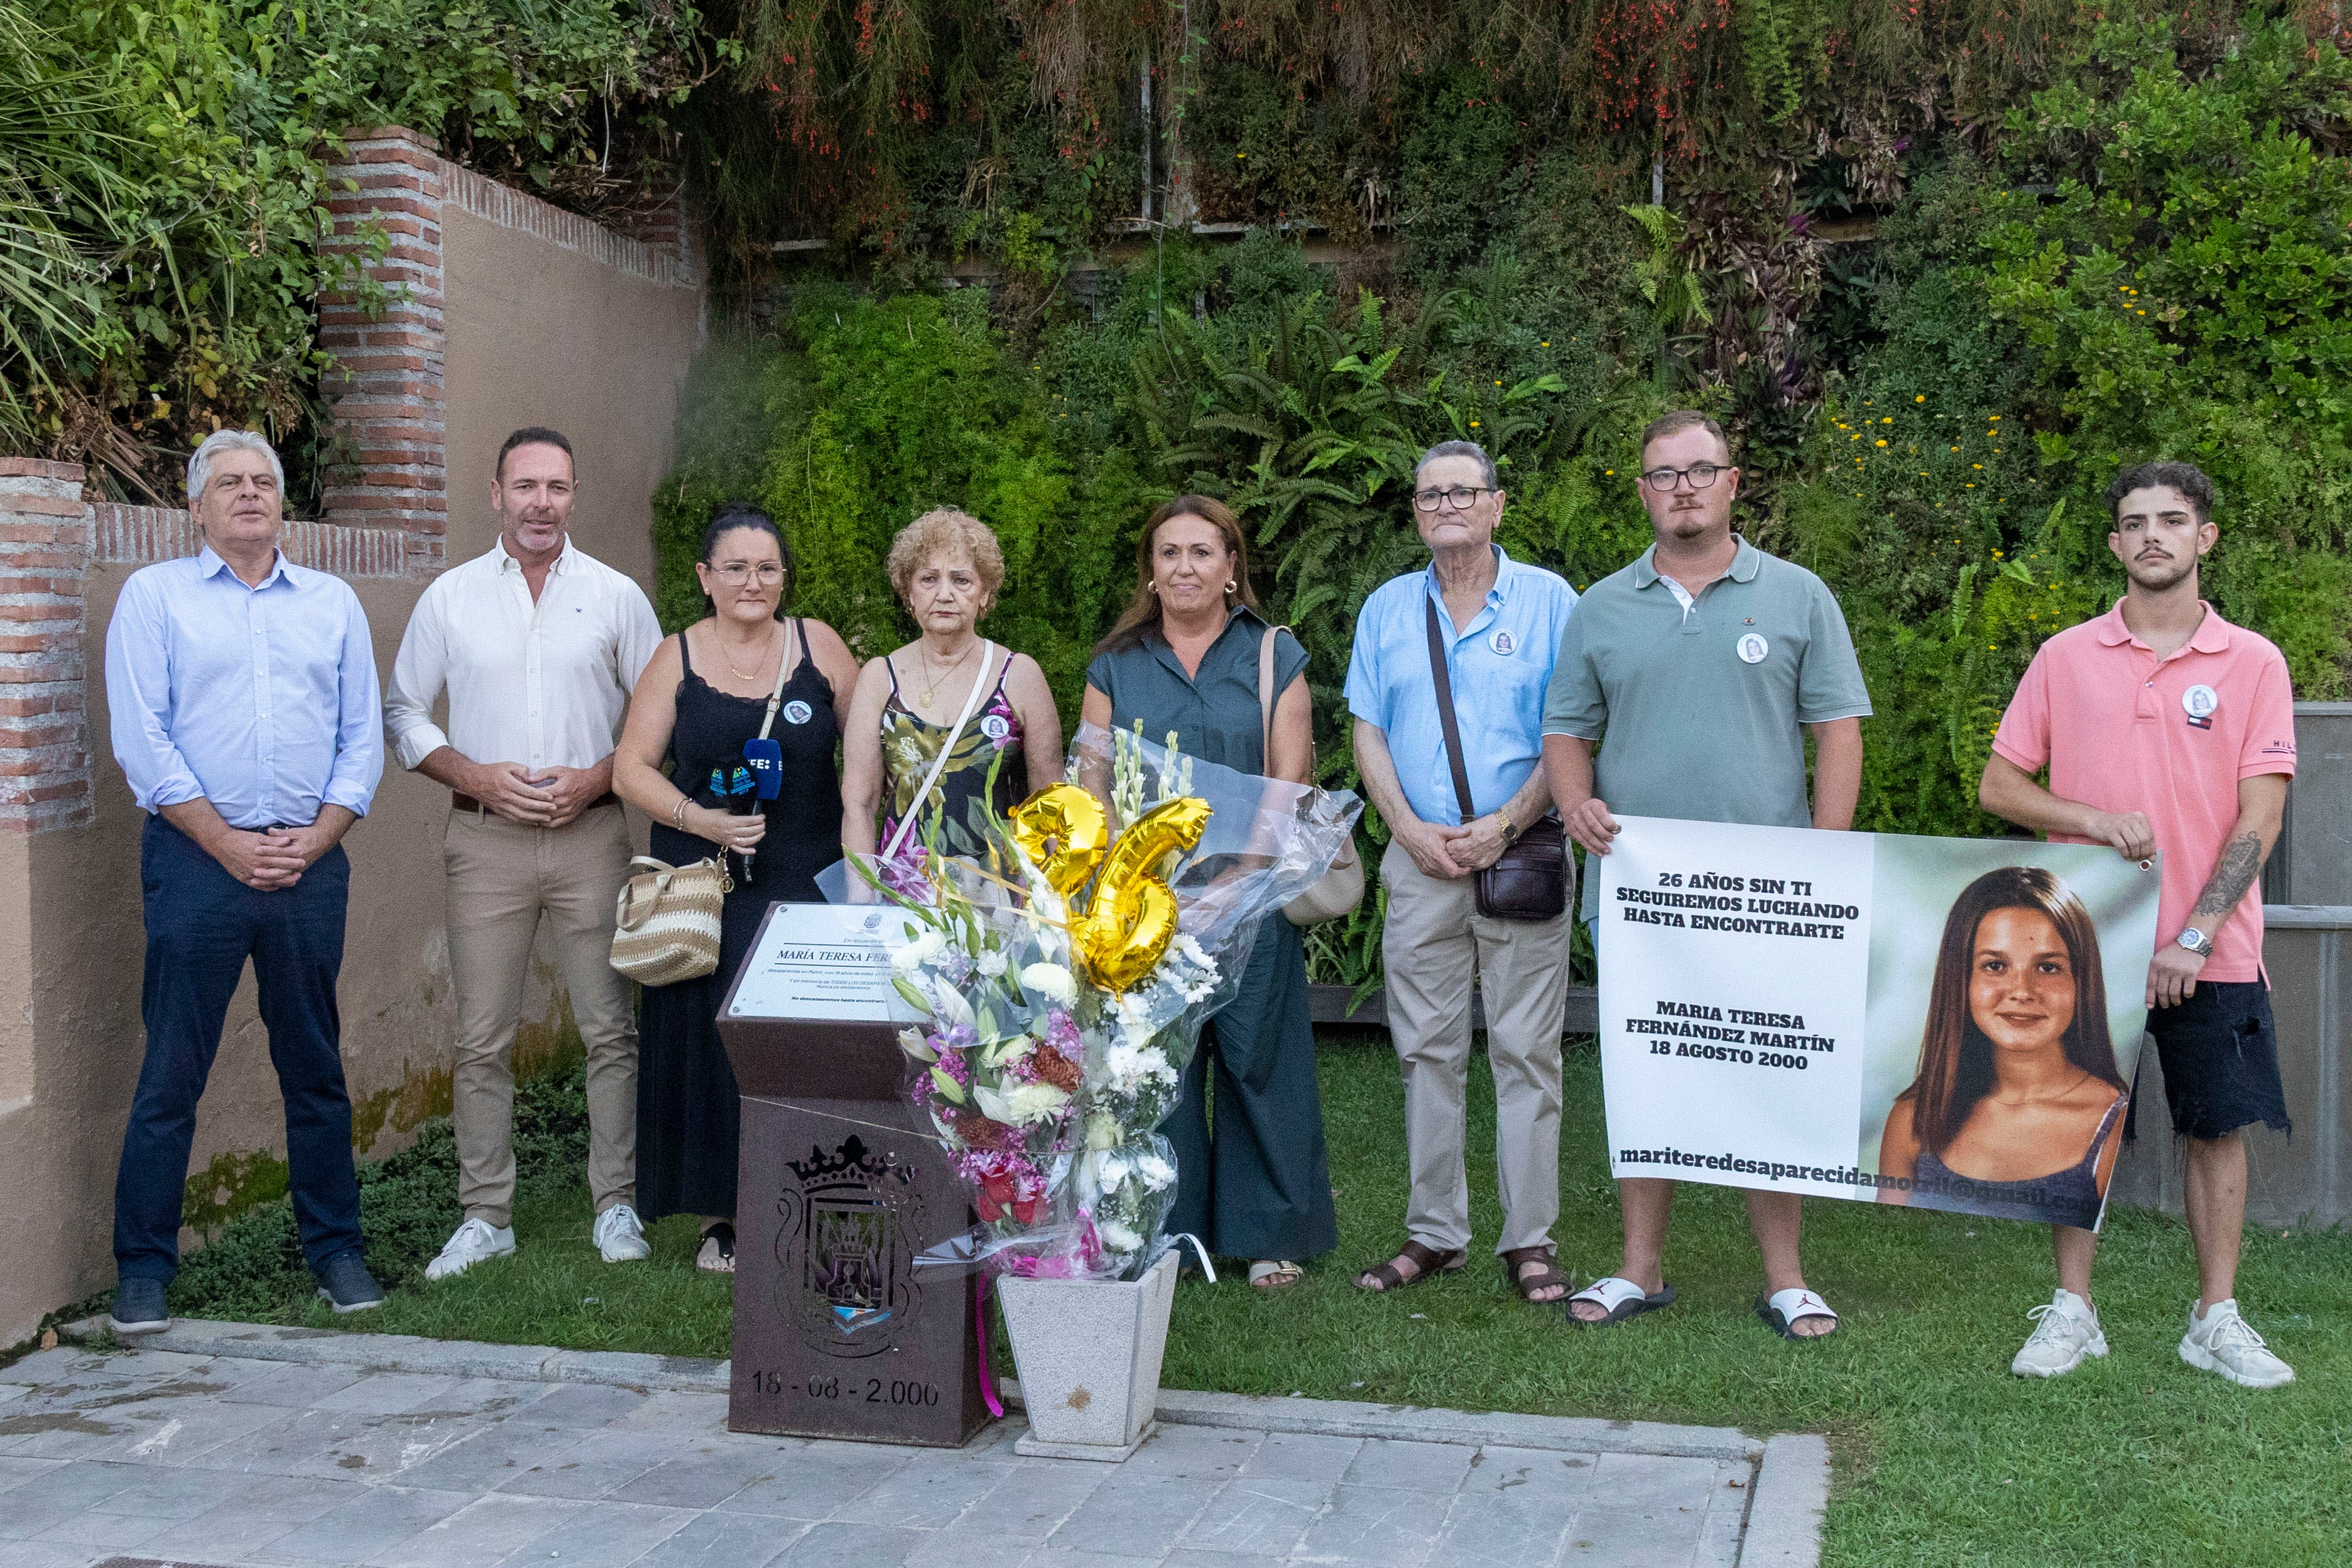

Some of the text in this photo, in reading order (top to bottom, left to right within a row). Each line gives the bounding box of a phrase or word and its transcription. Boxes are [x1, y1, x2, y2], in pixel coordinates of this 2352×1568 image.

[748, 759, 770, 770] FE:
[1658, 872, 1812, 896] 26 AÑOS SIN TI
[1616, 887, 1859, 920] SEGUIREMOS LUCHANDO
[1624, 907, 1844, 939] HASTA ENCONTRARTE
[776, 949, 814, 960] MARÍA
[819, 951, 862, 961] TERESA
[1657, 1001, 1805, 1030] MARIA TERESA
[1626, 1018, 1835, 1052] FERNÁNDEZ MARTÍN
[1650, 1040, 1808, 1070] 18 AGOSTO 2000
[753, 1369, 781, 1395] 18
[808, 1374, 839, 1399] 08
[866, 1378, 939, 1407] 2.000
